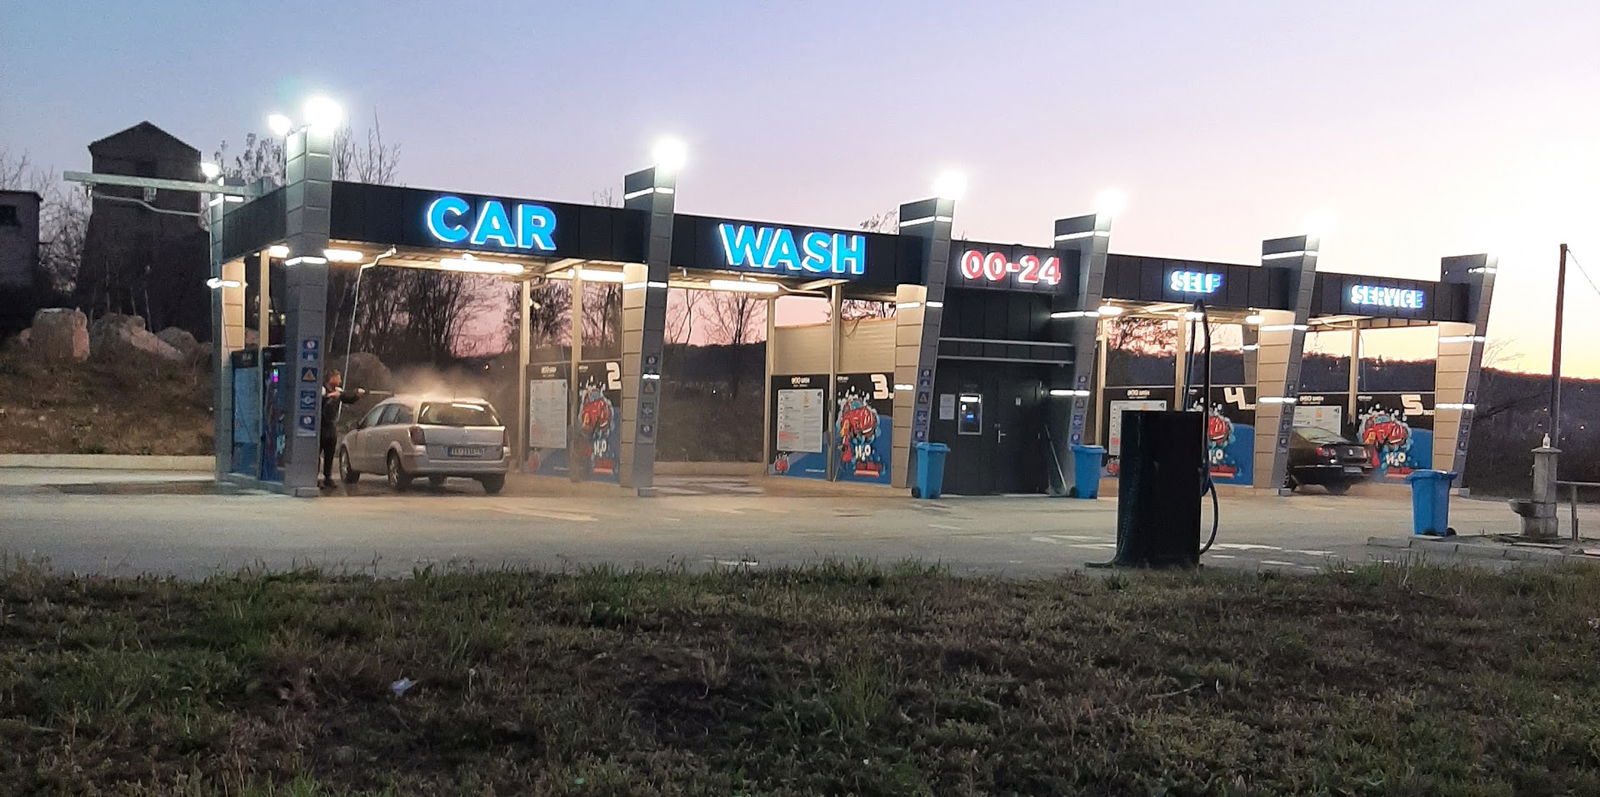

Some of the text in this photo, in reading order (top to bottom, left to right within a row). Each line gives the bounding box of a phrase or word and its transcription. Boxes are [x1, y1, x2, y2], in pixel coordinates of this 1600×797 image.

[427, 196, 866, 274] CAR WASH
[961, 249, 1062, 285] 00-24
[1169, 270, 1424, 309] SELF SERVICE
[606, 362, 622, 390] 2
